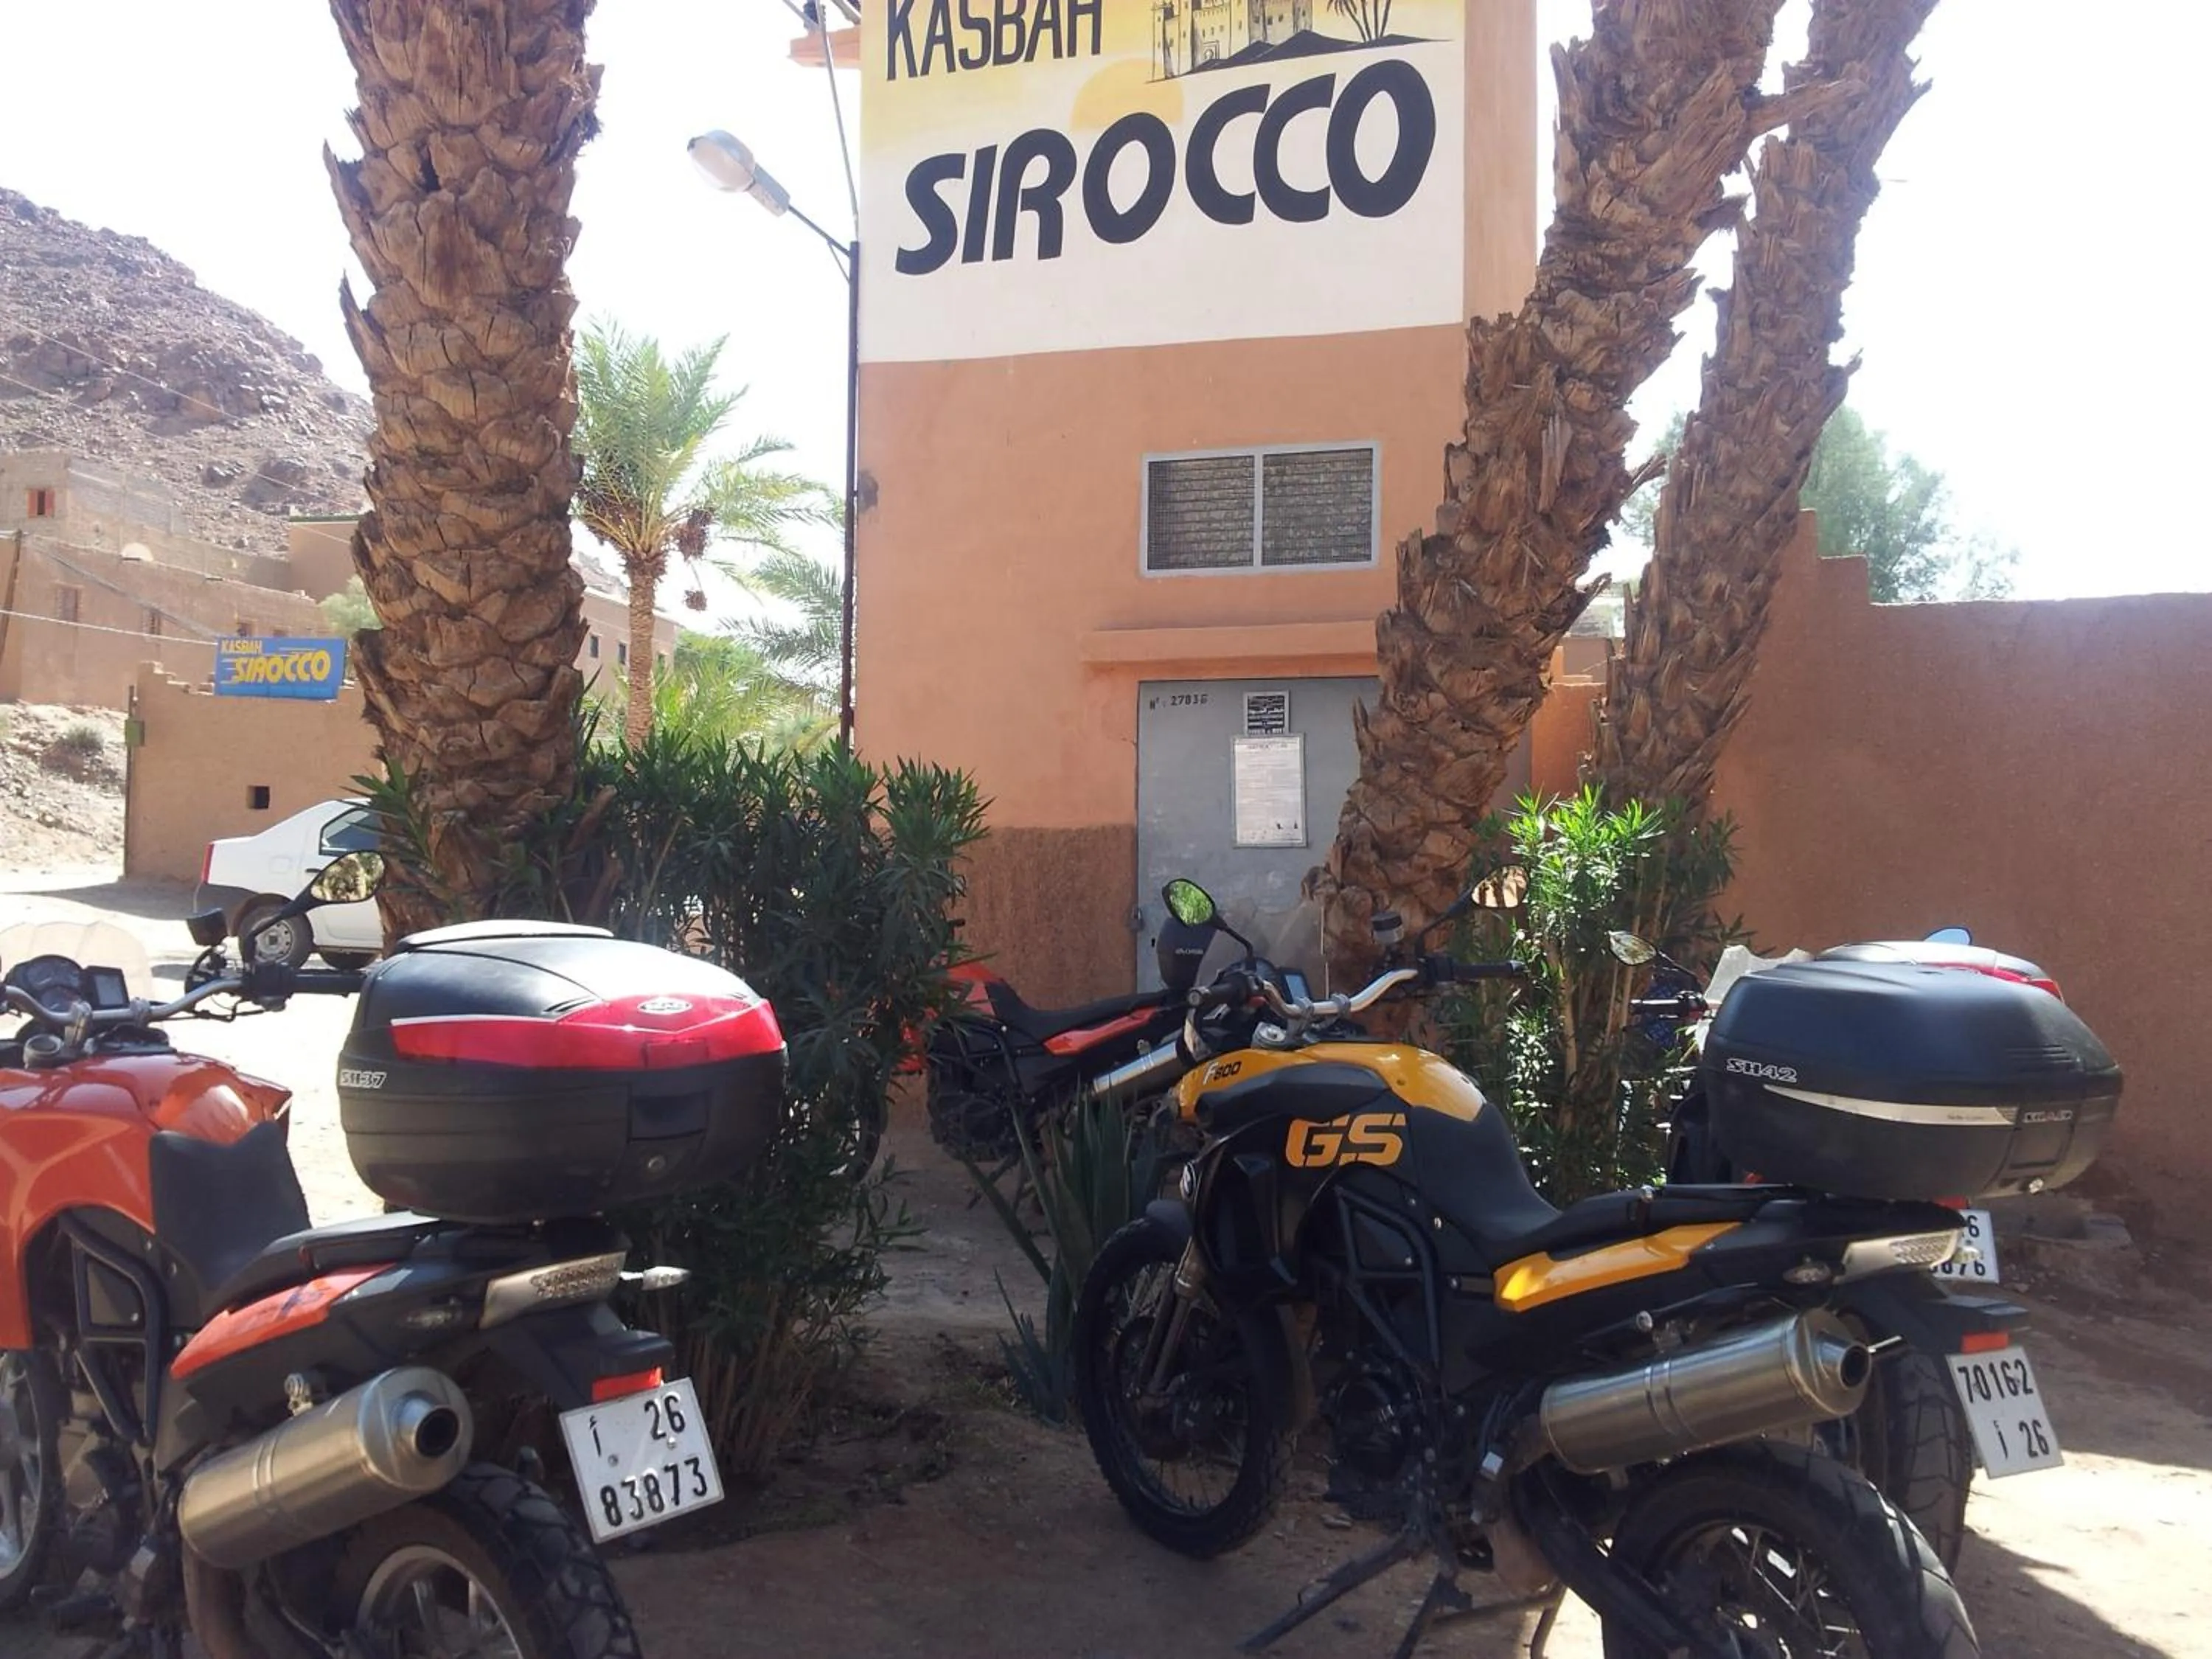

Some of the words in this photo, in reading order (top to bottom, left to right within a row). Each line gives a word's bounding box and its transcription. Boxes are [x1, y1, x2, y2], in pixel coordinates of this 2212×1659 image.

[886, 0, 1102, 81] KASBAH
[895, 58, 1436, 276] SIROCCO
[220, 639, 263, 654] KASBAH
[231, 649, 331, 684] SIROCCO
[1726, 1057, 1798, 1084] SH42
[1285, 1113, 1406, 1168] GS
[1958, 1358, 2034, 1404] 70162
[644, 1394, 686, 1441] 26
[2019, 1419, 2050, 1458] 26
[599, 1456, 708, 1527] 83873
